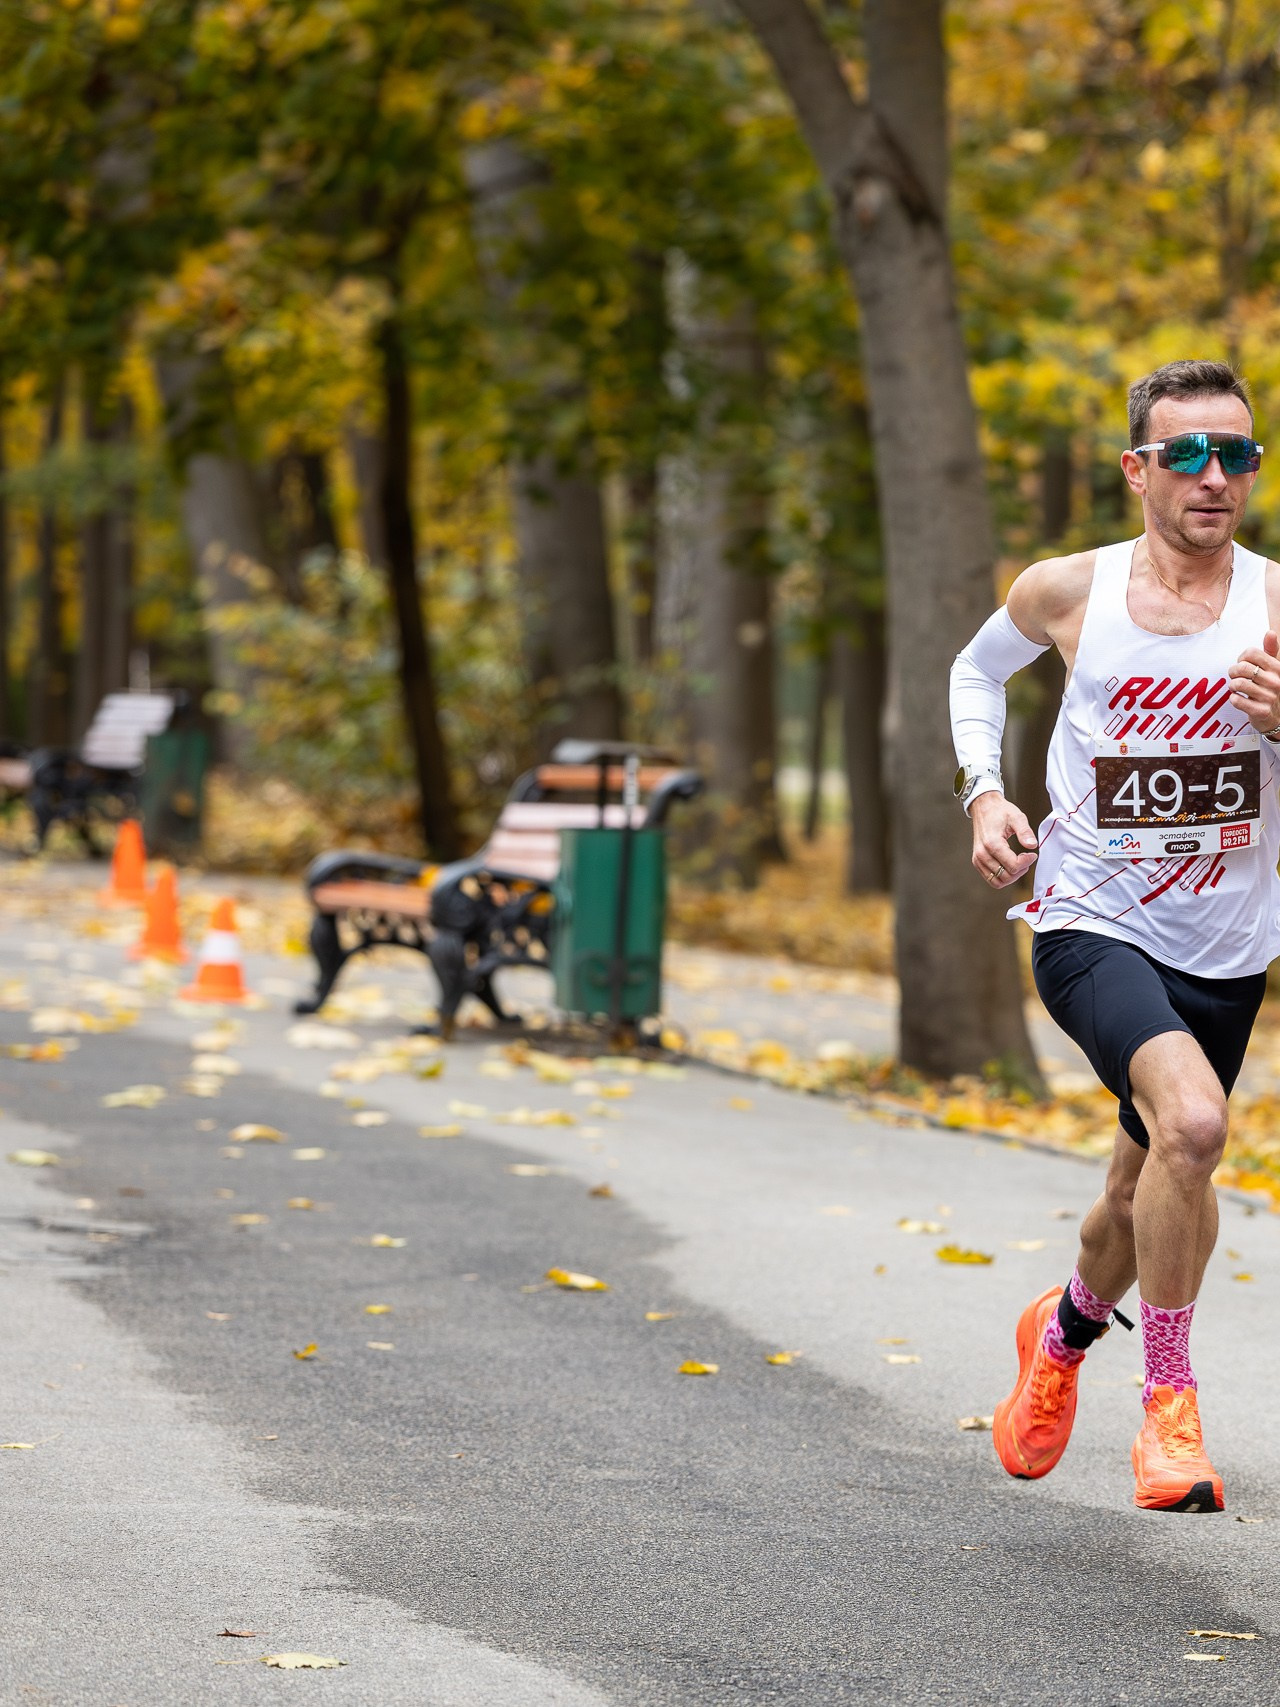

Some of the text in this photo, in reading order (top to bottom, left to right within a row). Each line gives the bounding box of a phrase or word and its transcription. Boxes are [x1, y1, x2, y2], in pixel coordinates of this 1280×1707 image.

[1108, 677, 1226, 711] RUN
[1112, 766, 1245, 817] 49-5
[1158, 831, 1206, 840] эстафета
[1222, 835, 1248, 847] 89.2 FM
